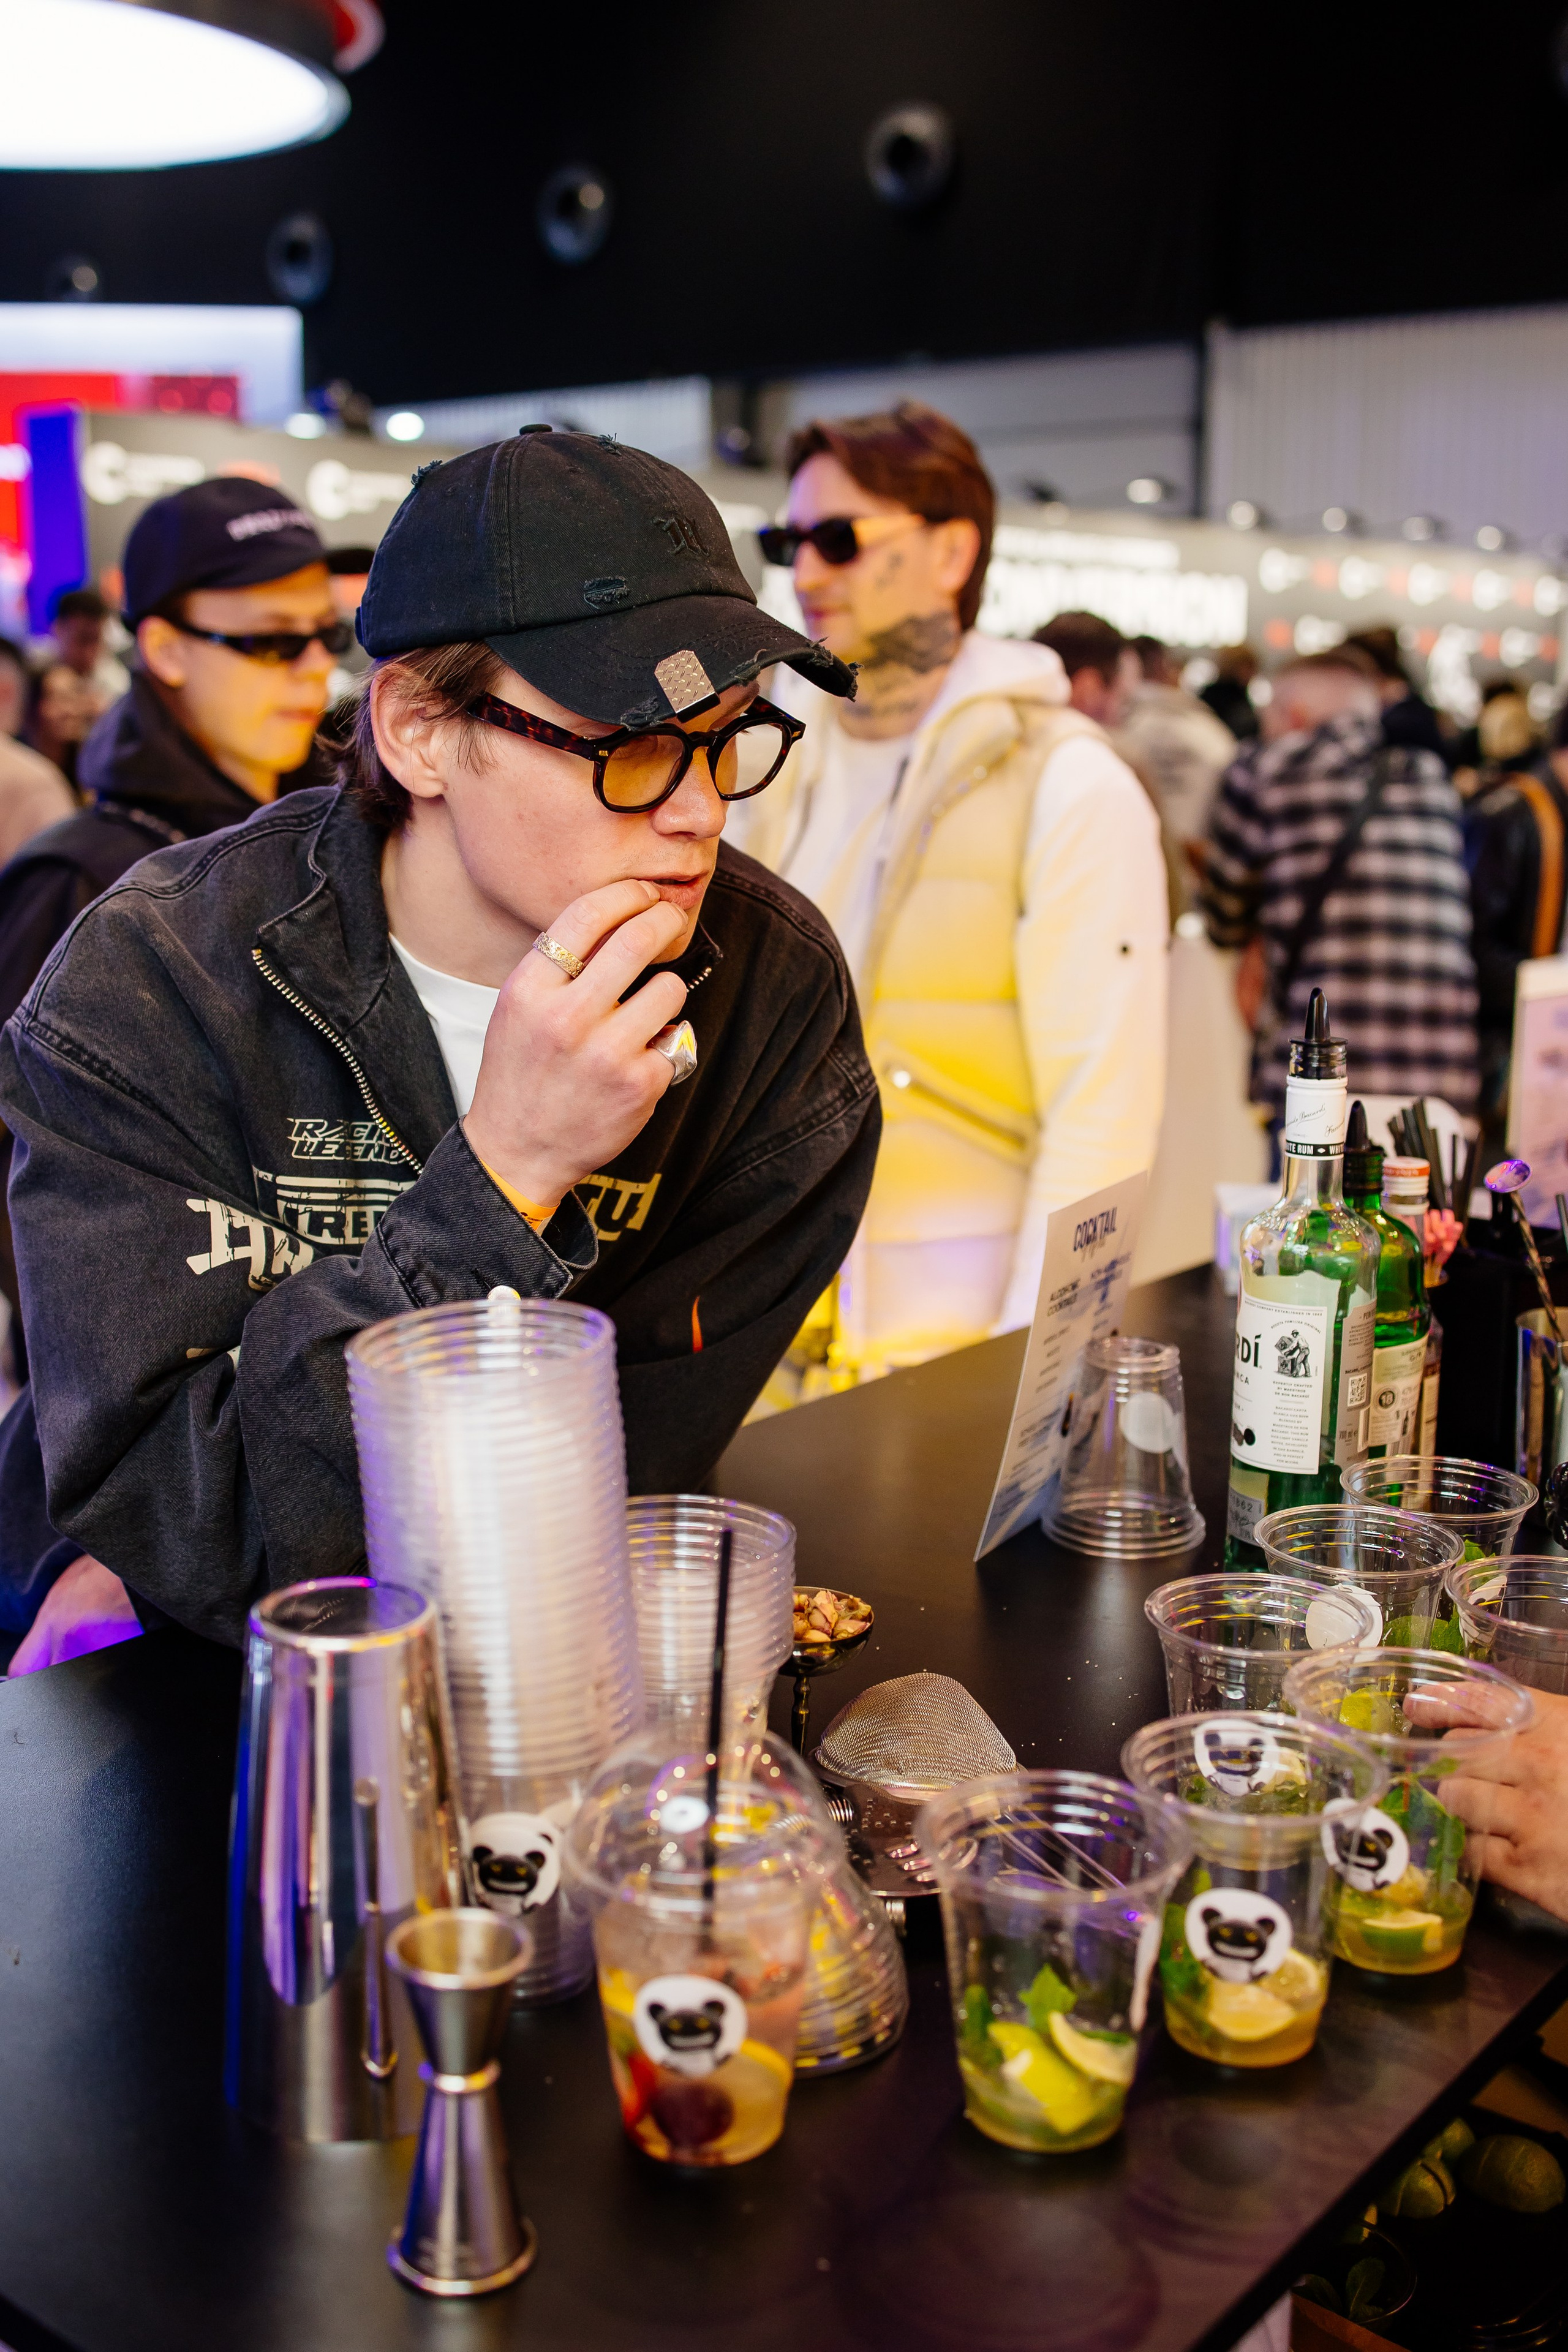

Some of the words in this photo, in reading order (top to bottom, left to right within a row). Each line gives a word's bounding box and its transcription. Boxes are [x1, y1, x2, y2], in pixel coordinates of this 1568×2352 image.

[1297, 1144, 1314, 1155] RUM
[1329, 1143, 1344, 1155] WHIT
[1074, 1206, 1118, 1252] COCKTAIL
